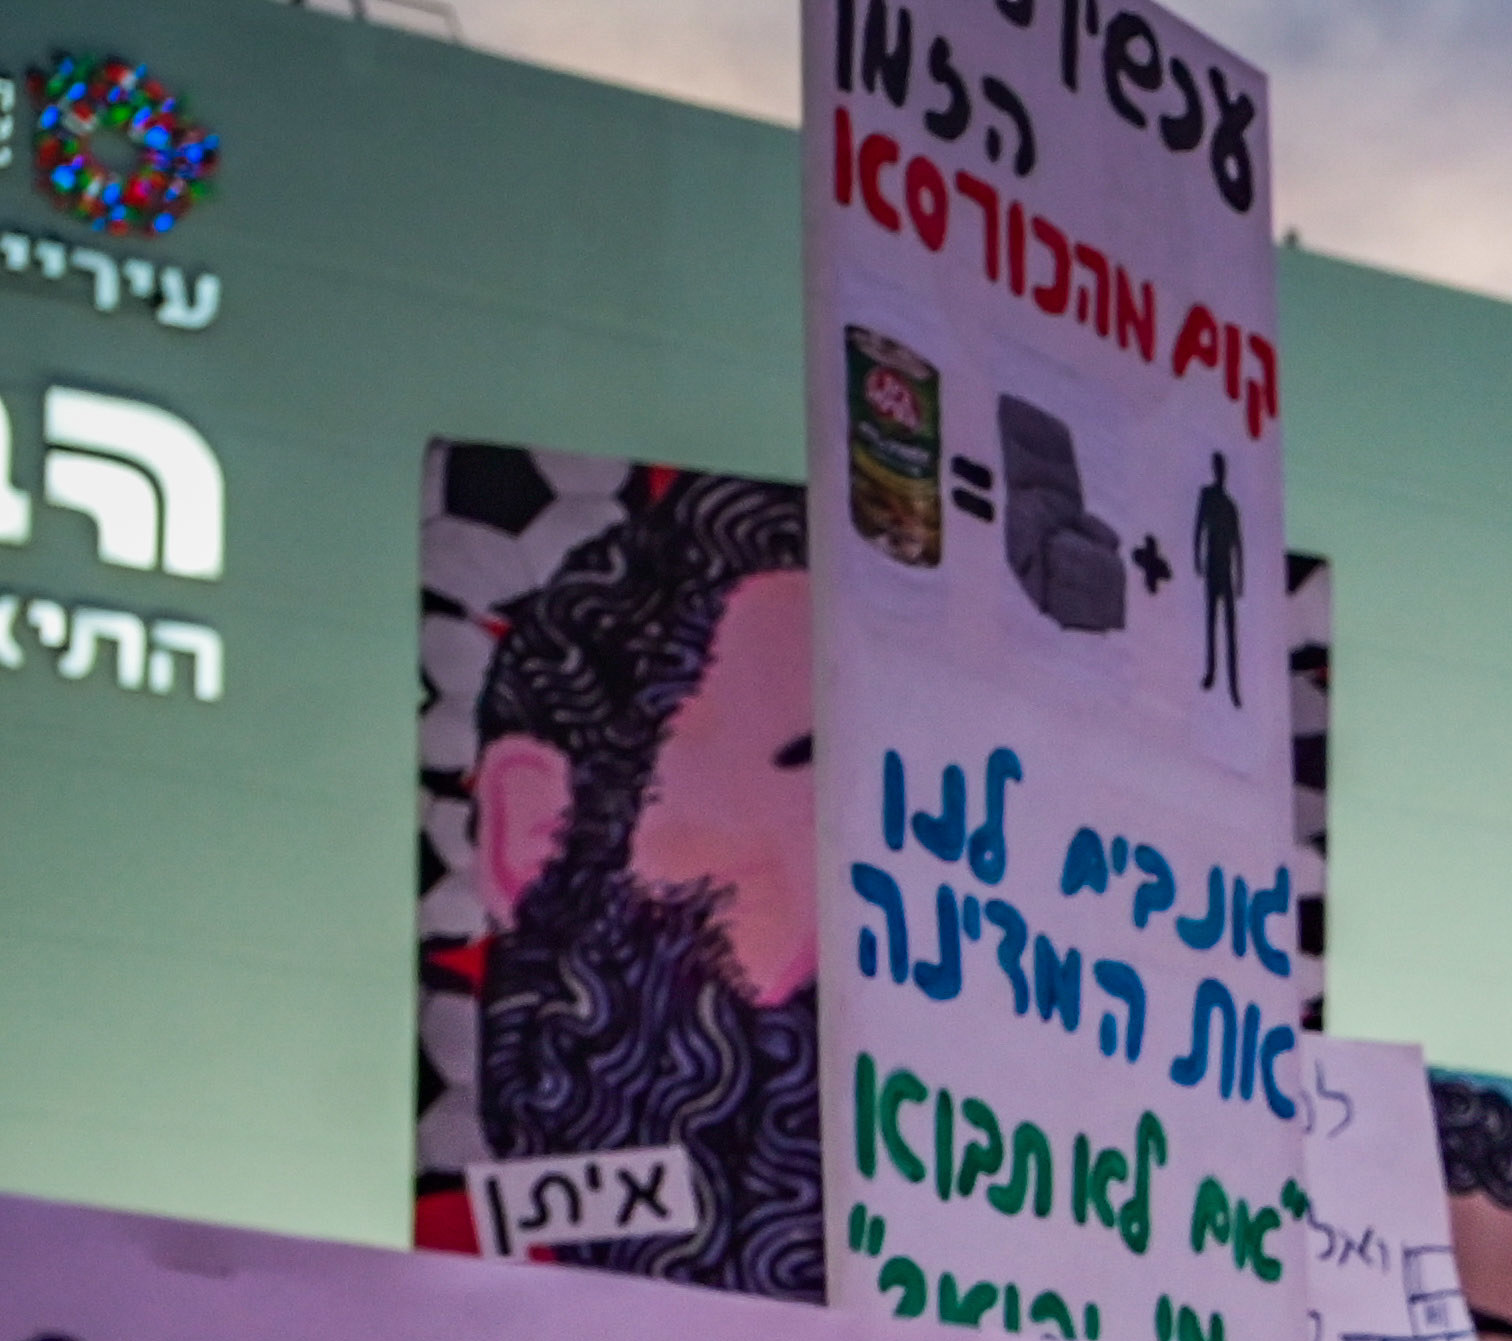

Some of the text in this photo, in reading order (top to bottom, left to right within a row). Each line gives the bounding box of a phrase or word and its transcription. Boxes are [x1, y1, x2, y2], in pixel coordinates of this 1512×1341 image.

[1171, 303, 1278, 440] קום
[883, 747, 1022, 886] לנו
[850, 862, 1147, 1063] המדינה
[1169, 978, 1296, 1119] את
[1072, 1111, 1167, 1255] לא
